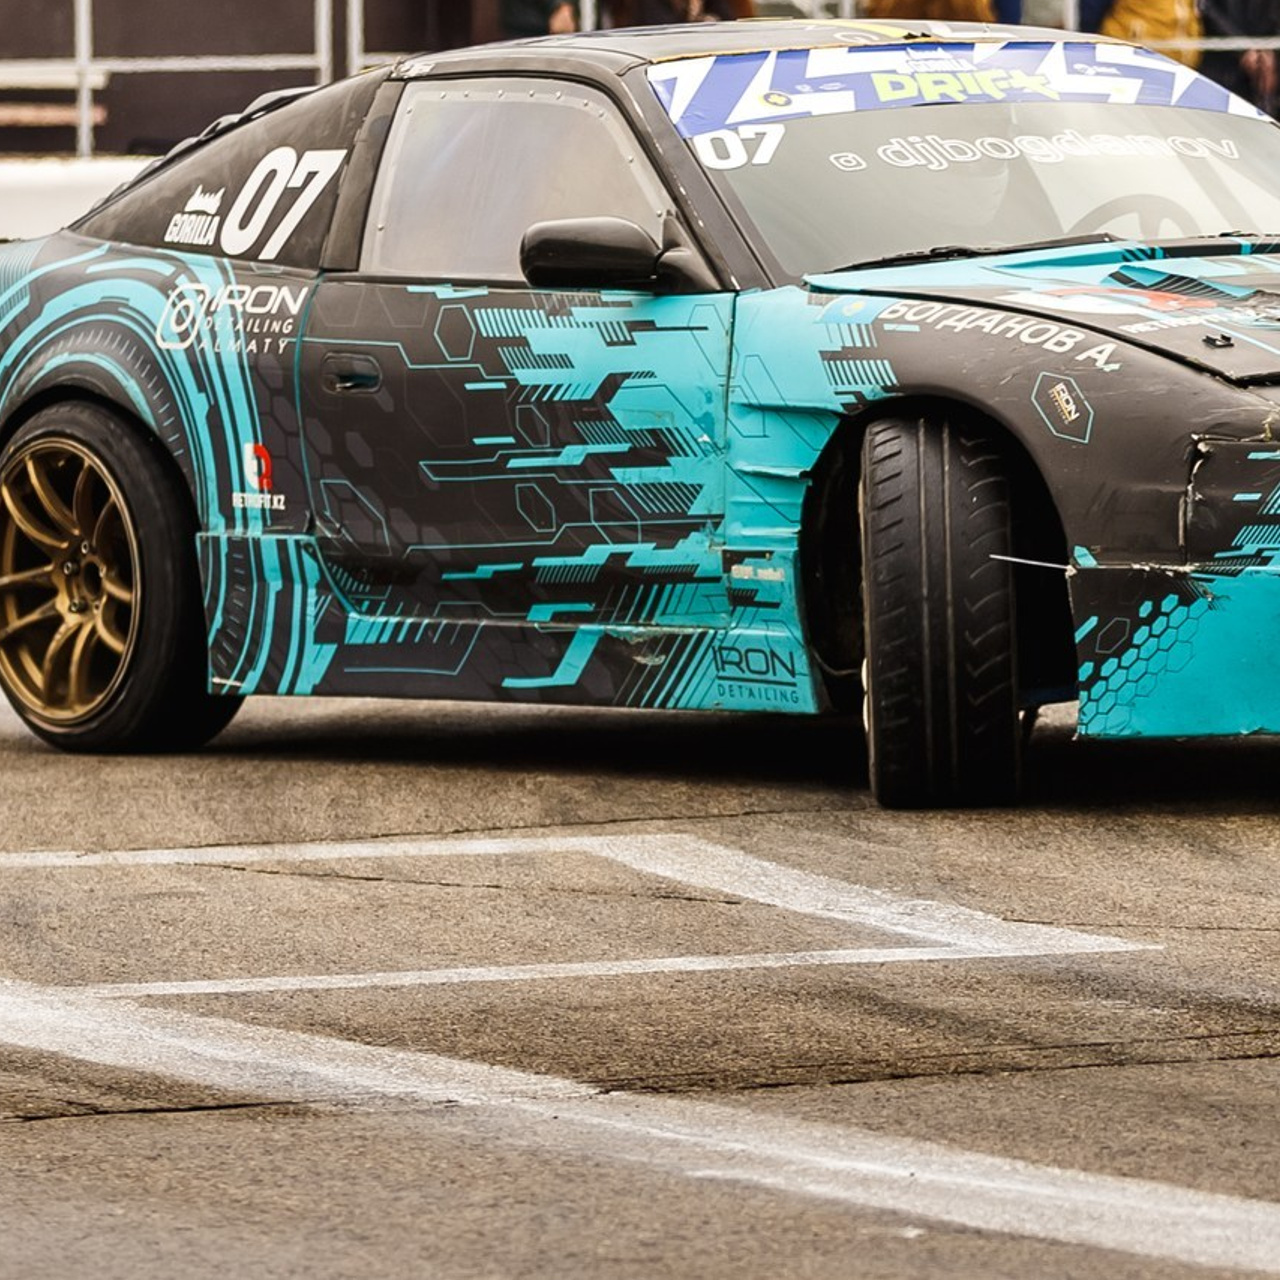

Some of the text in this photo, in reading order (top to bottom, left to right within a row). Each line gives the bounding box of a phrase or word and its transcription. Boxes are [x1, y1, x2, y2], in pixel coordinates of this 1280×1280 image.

[871, 69, 1061, 102] DRIFT
[695, 123, 786, 170] 07
[877, 129, 1239, 170] djbogdanov
[219, 145, 348, 261] 07
[164, 212, 221, 246] GORILLA
[210, 284, 309, 315] IRON
[203, 317, 294, 334] DETAILING
[878, 301, 1086, 353] БОГДАНОВ
[198, 336, 288, 354] ALMATY
[711, 645, 797, 678] IRON
[718, 684, 799, 703] DETAILING
